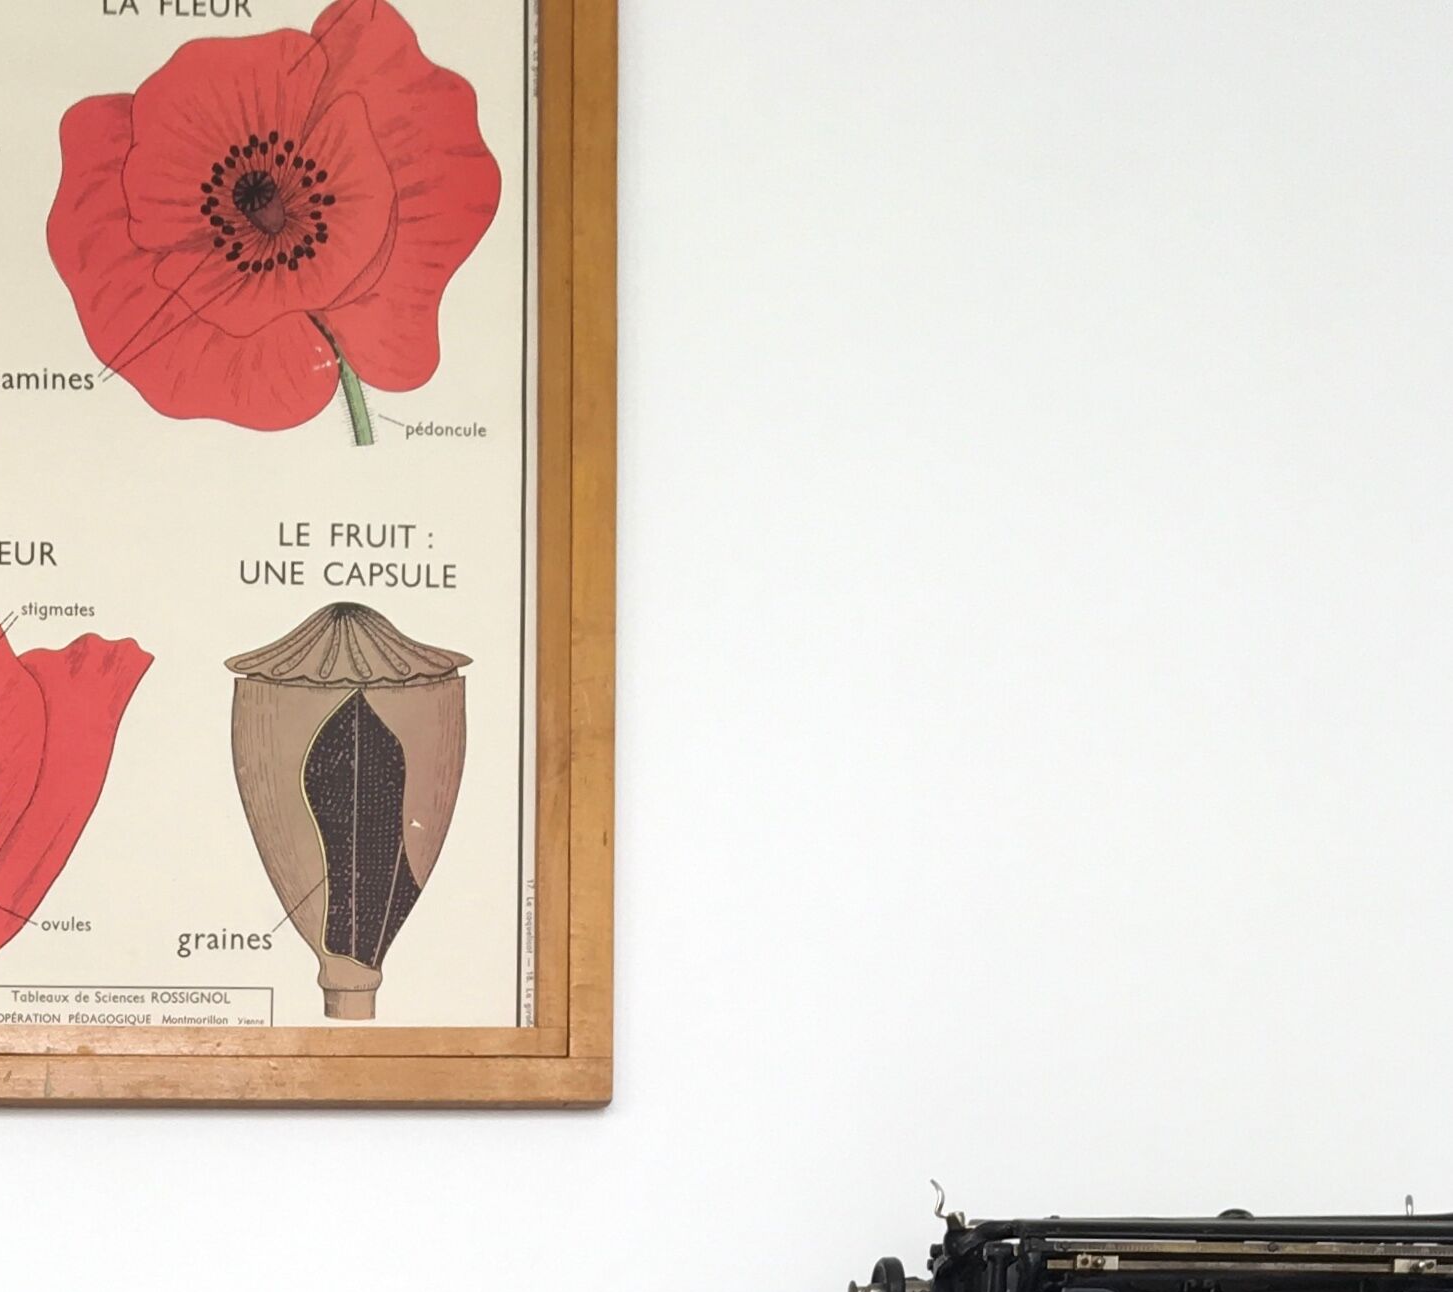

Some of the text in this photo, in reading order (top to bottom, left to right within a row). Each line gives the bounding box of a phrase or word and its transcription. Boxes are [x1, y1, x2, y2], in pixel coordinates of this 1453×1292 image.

[102, 0, 252, 18] LA FLEUR
[405, 422, 487, 440] pédoncule
[279, 522, 310, 547] LE
[330, 523, 416, 549] FRUIT
[240, 560, 457, 589] UNE CAPSULE
[21, 602, 95, 619] stigmates
[41, 917, 92, 932] ovules
[176, 927, 273, 953] graines
[10, 990, 231, 1005] Tableaux de Sciences ROSSIGNOL
[68, 1012, 152, 1026] PÉDAGOGIQUE
[161, 1014, 229, 1025] Montmorillon
